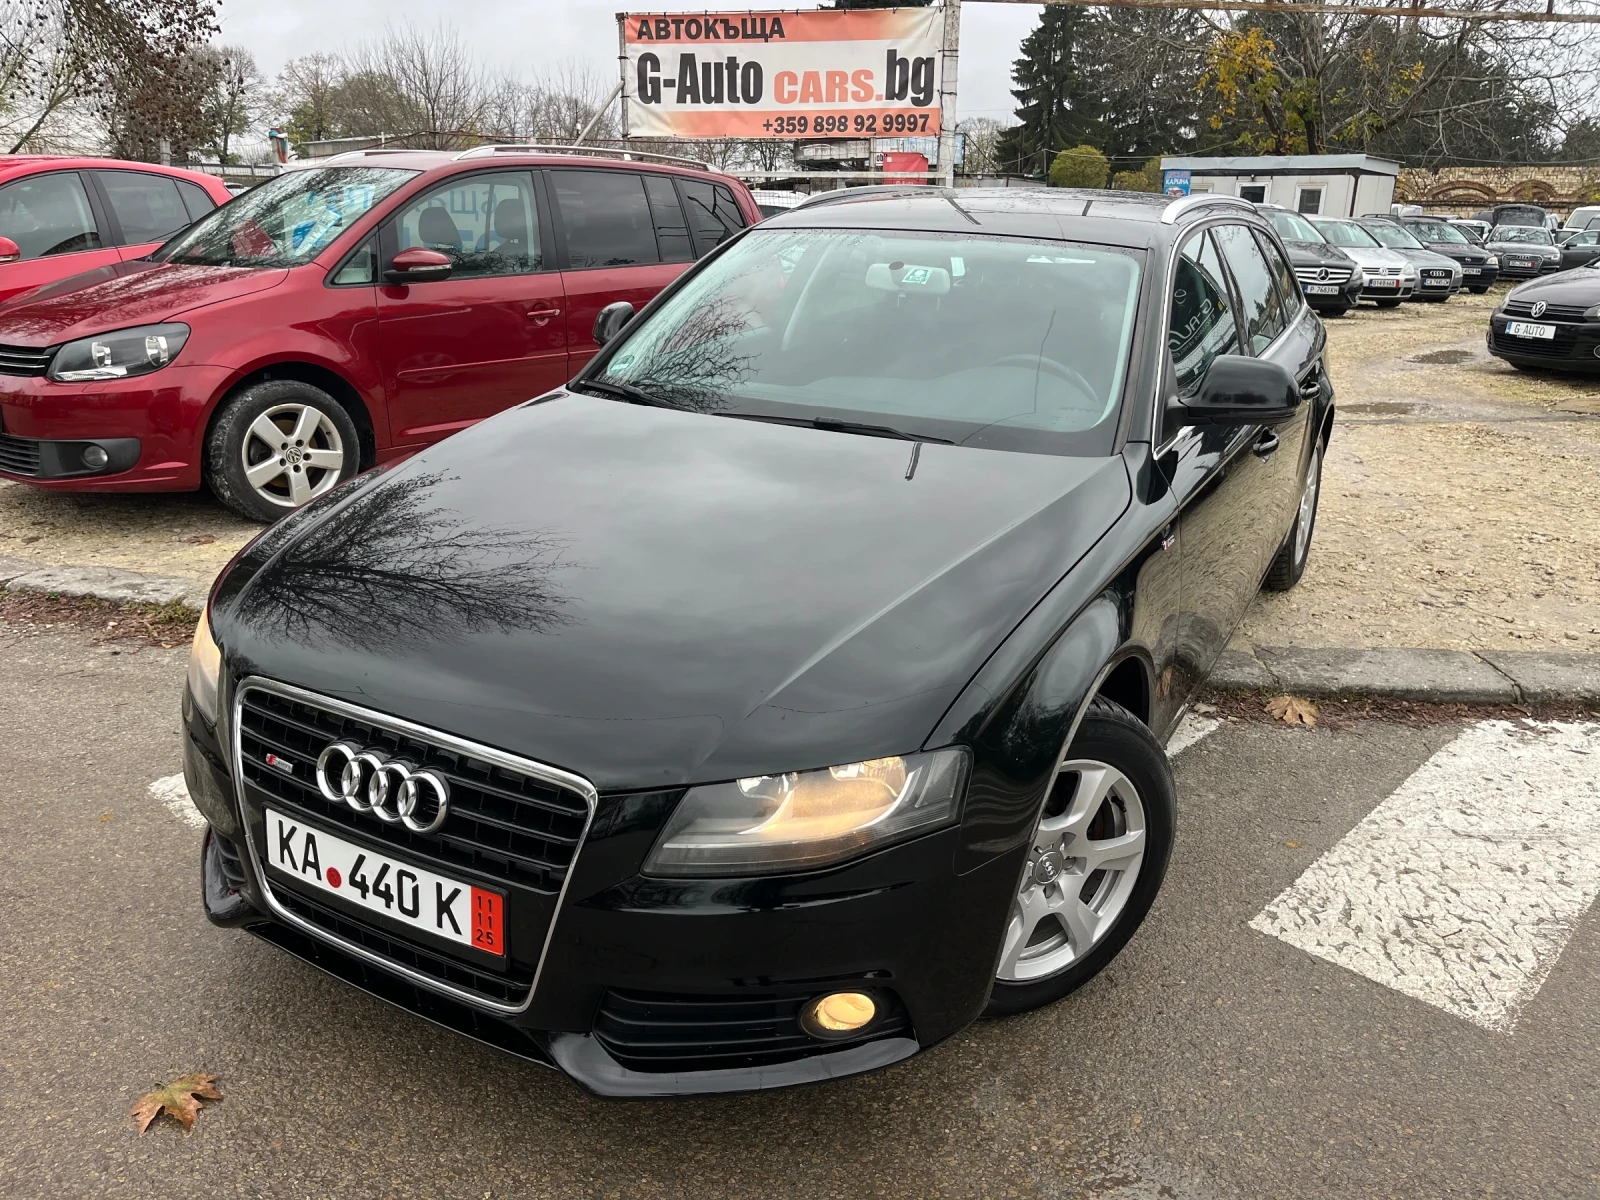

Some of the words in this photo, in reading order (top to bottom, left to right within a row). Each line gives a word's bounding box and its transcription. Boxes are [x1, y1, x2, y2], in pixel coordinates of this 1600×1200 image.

[637, 17, 786, 42] АВТОКЪЩА
[637, 52, 764, 105] G-Auto
[773, 49, 936, 107] CARS.bg
[762, 115, 808, 134] +359
[813, 114, 850, 133] 898
[853, 114, 877, 132] 92
[882, 113, 930, 133] 9997
[1514, 323, 1521, 334] G
[1523, 324, 1546, 337] AUTO
[278, 819, 323, 882] KA
[348, 853, 420, 919] 440
[435, 881, 463, 936] K
[477, 895, 492, 913] 11
[477, 912, 493, 930] 11
[476, 928, 494, 946] 25
